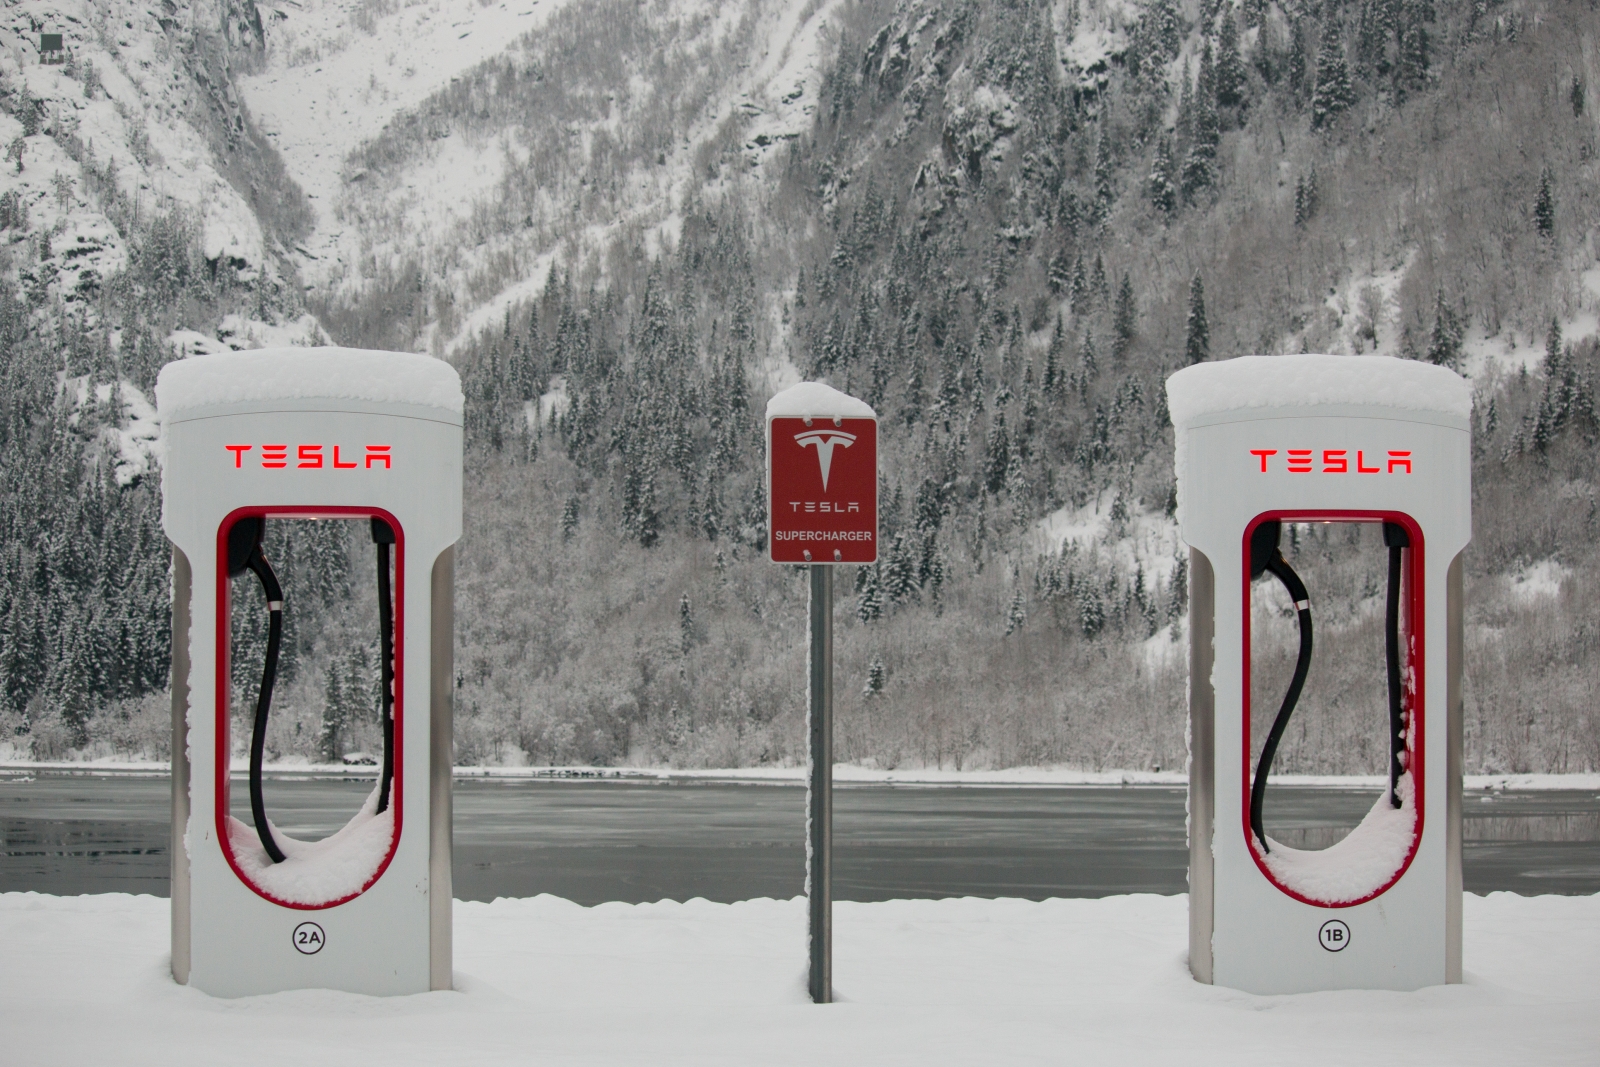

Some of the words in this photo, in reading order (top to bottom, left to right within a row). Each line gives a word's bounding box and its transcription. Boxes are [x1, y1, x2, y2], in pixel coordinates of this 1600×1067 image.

[225, 444, 392, 470] TESLA
[1250, 449, 1412, 474] TESLA
[789, 502, 859, 512] TESLA
[775, 531, 872, 541] SUPERCHARGER
[298, 931, 321, 944] 2A
[1325, 929, 1343, 941] 1B
